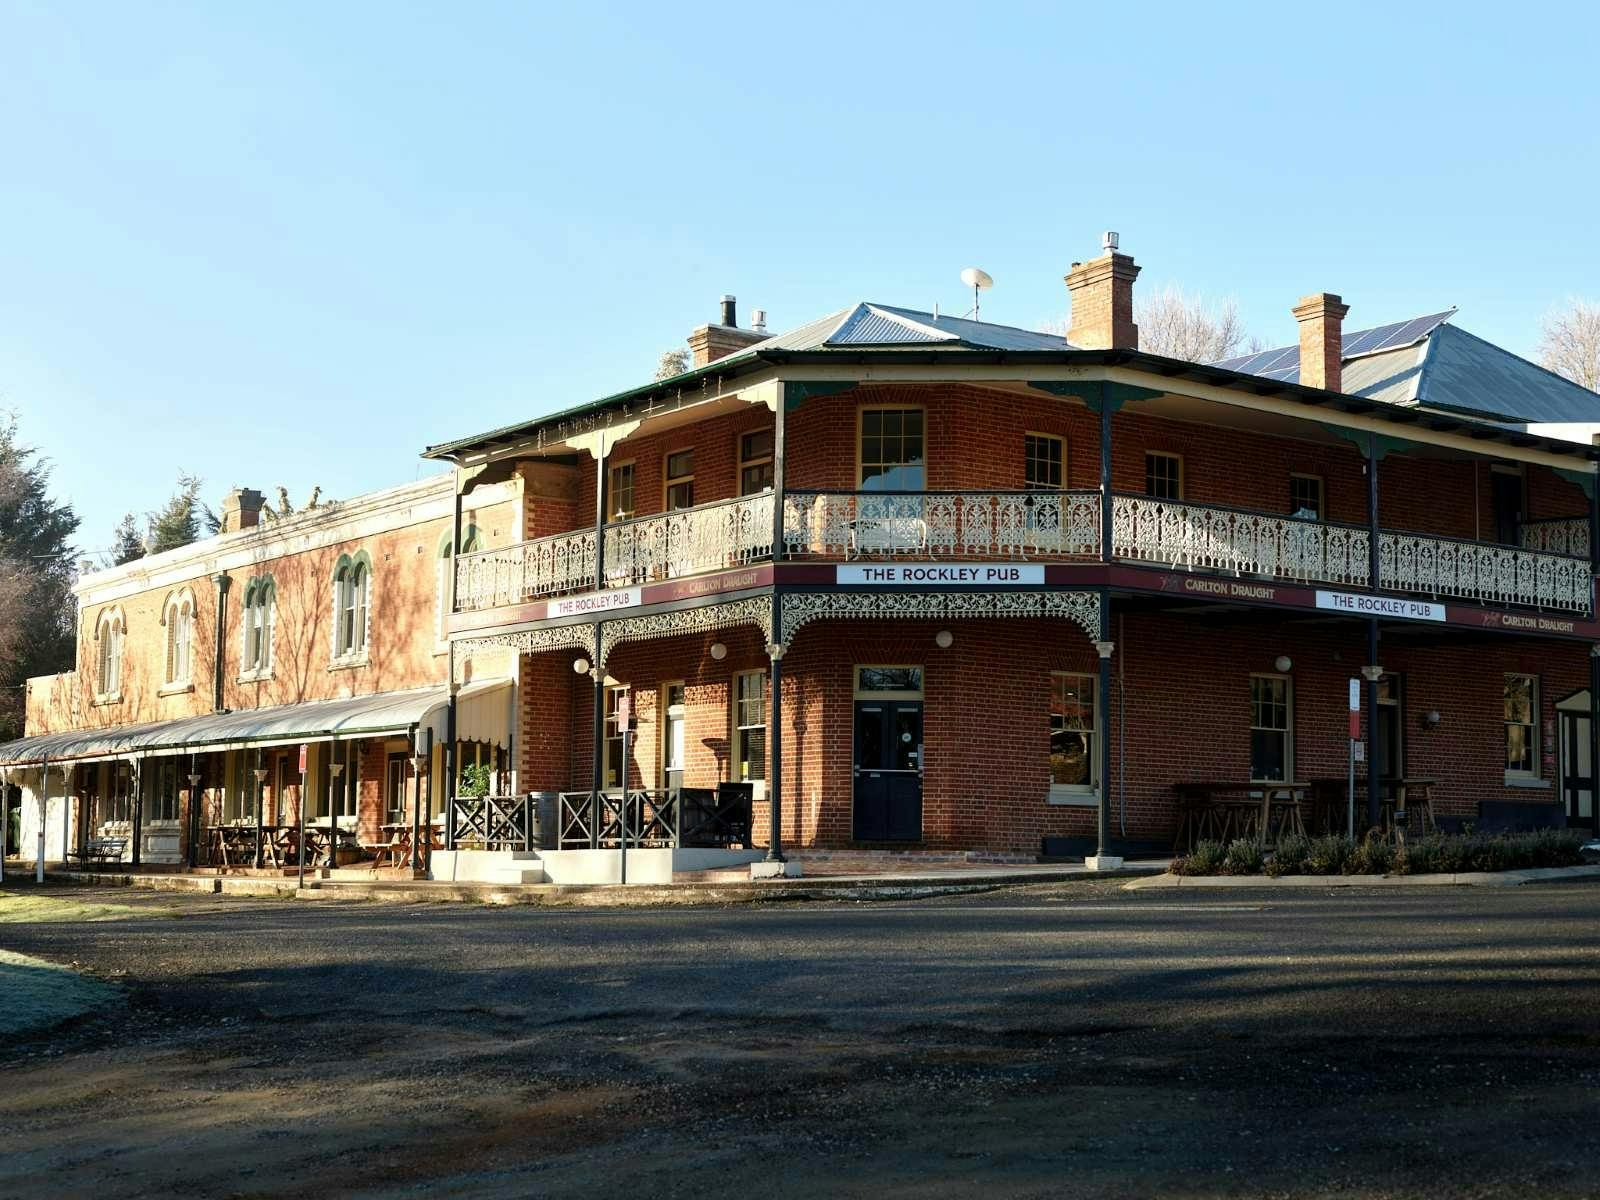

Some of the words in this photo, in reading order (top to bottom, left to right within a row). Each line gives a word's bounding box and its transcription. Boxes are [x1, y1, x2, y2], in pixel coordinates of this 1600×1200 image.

[863, 568, 895, 580] THE
[903, 568, 979, 581] ROCKLEY
[987, 568, 1020, 581] PUB
[1185, 579, 1227, 594] CARLTON
[1231, 583, 1275, 599] DRAUGHT
[560, 601, 573, 613] THE
[576, 596, 610, 610] ROCKLEY
[613, 593, 629, 605] PUB
[1332, 595, 1354, 608] THE
[1358, 598, 1406, 613] ROCKLEY
[1410, 604, 1431, 616] PUB
[1502, 615, 1537, 629] CARLTON
[1538, 619, 1574, 632] DRAUGHT
